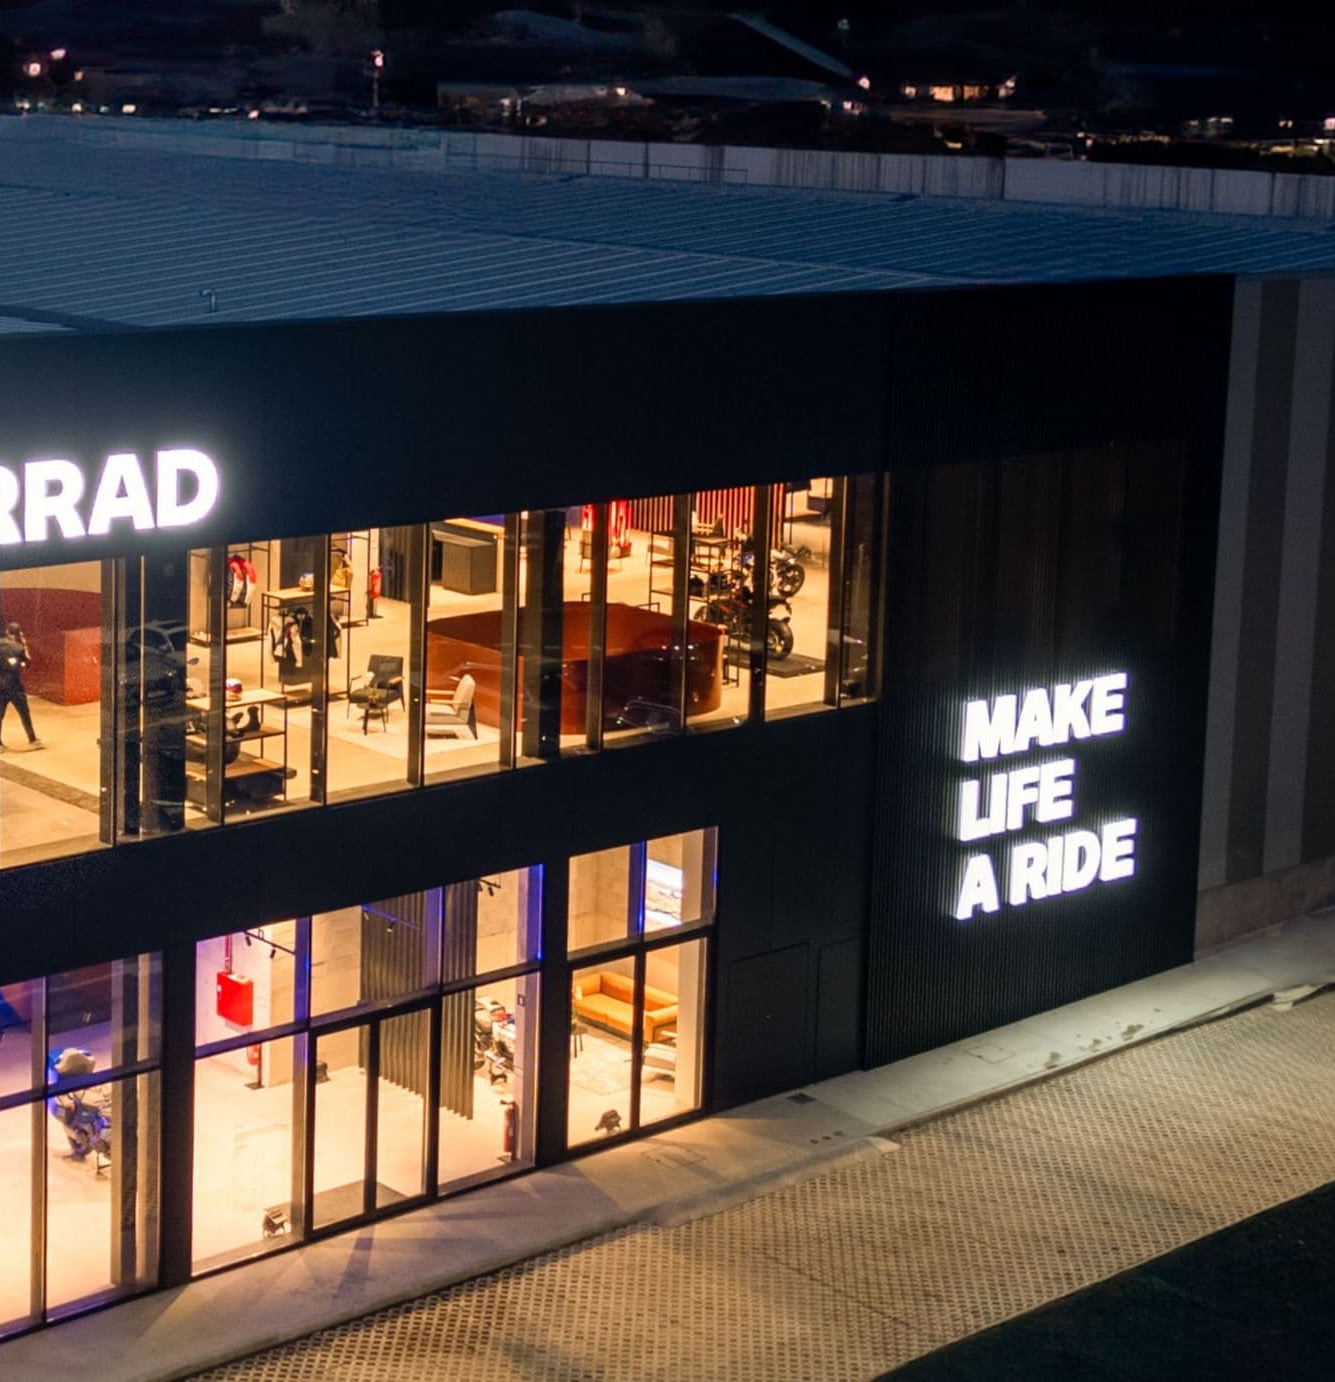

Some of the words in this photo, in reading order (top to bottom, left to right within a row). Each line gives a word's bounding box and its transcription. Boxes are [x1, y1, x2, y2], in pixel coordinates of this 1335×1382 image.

[962, 672, 1127, 763] MAKE
[959, 758, 1075, 842] LIFE
[955, 853, 999, 920] A
[1009, 818, 1137, 906] RIDE
